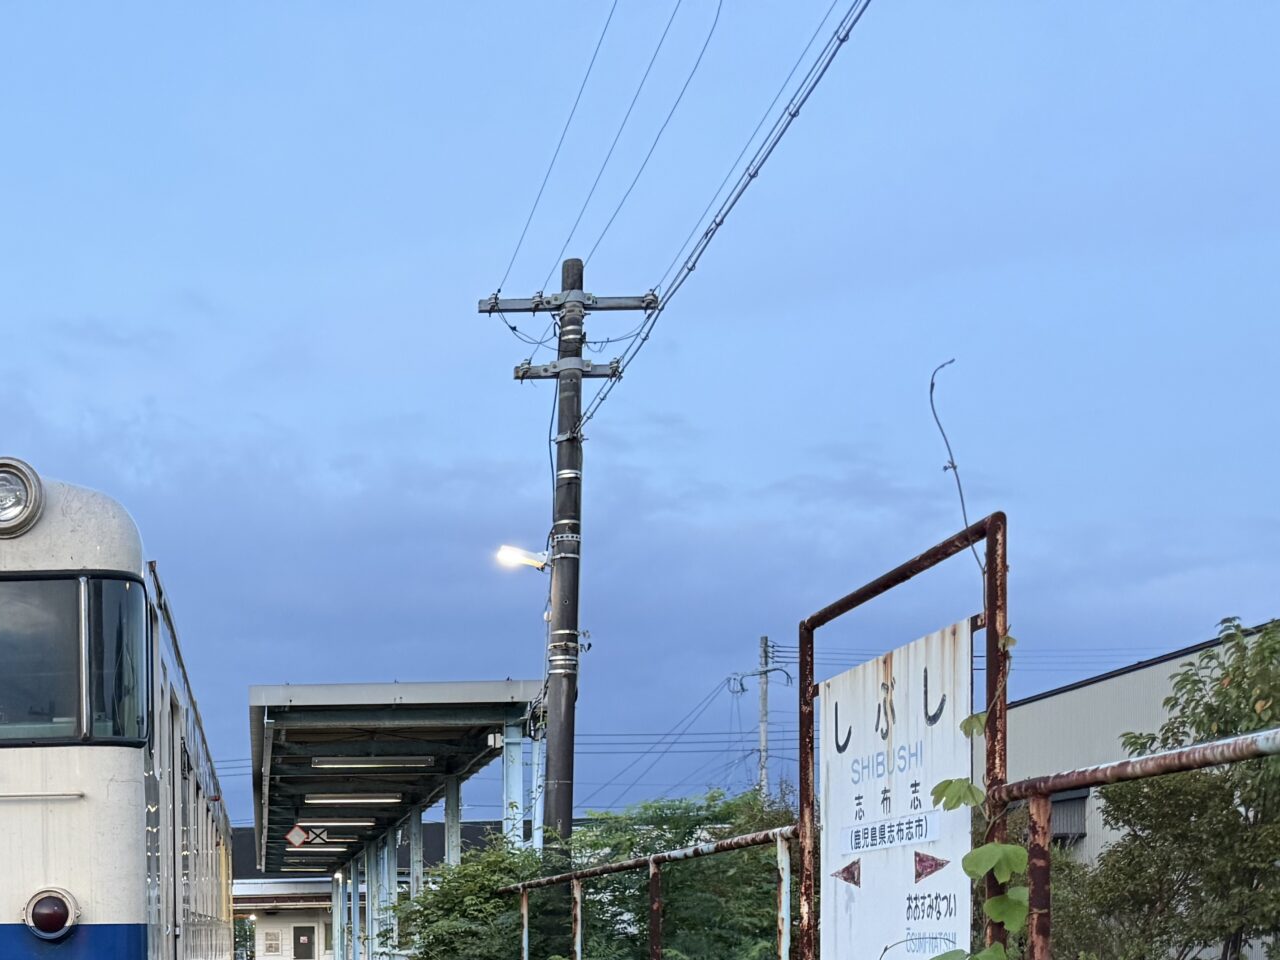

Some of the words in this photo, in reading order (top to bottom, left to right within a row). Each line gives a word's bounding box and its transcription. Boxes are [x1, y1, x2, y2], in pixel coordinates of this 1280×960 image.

[835, 666, 946, 754] しぶし
[851, 740, 923, 785] SHIBUSHI
[854, 780, 922, 821] 志布志
[850, 815, 928, 851] (鹿児島県志布志市)
[906, 891, 956, 921] おおすみなつい
